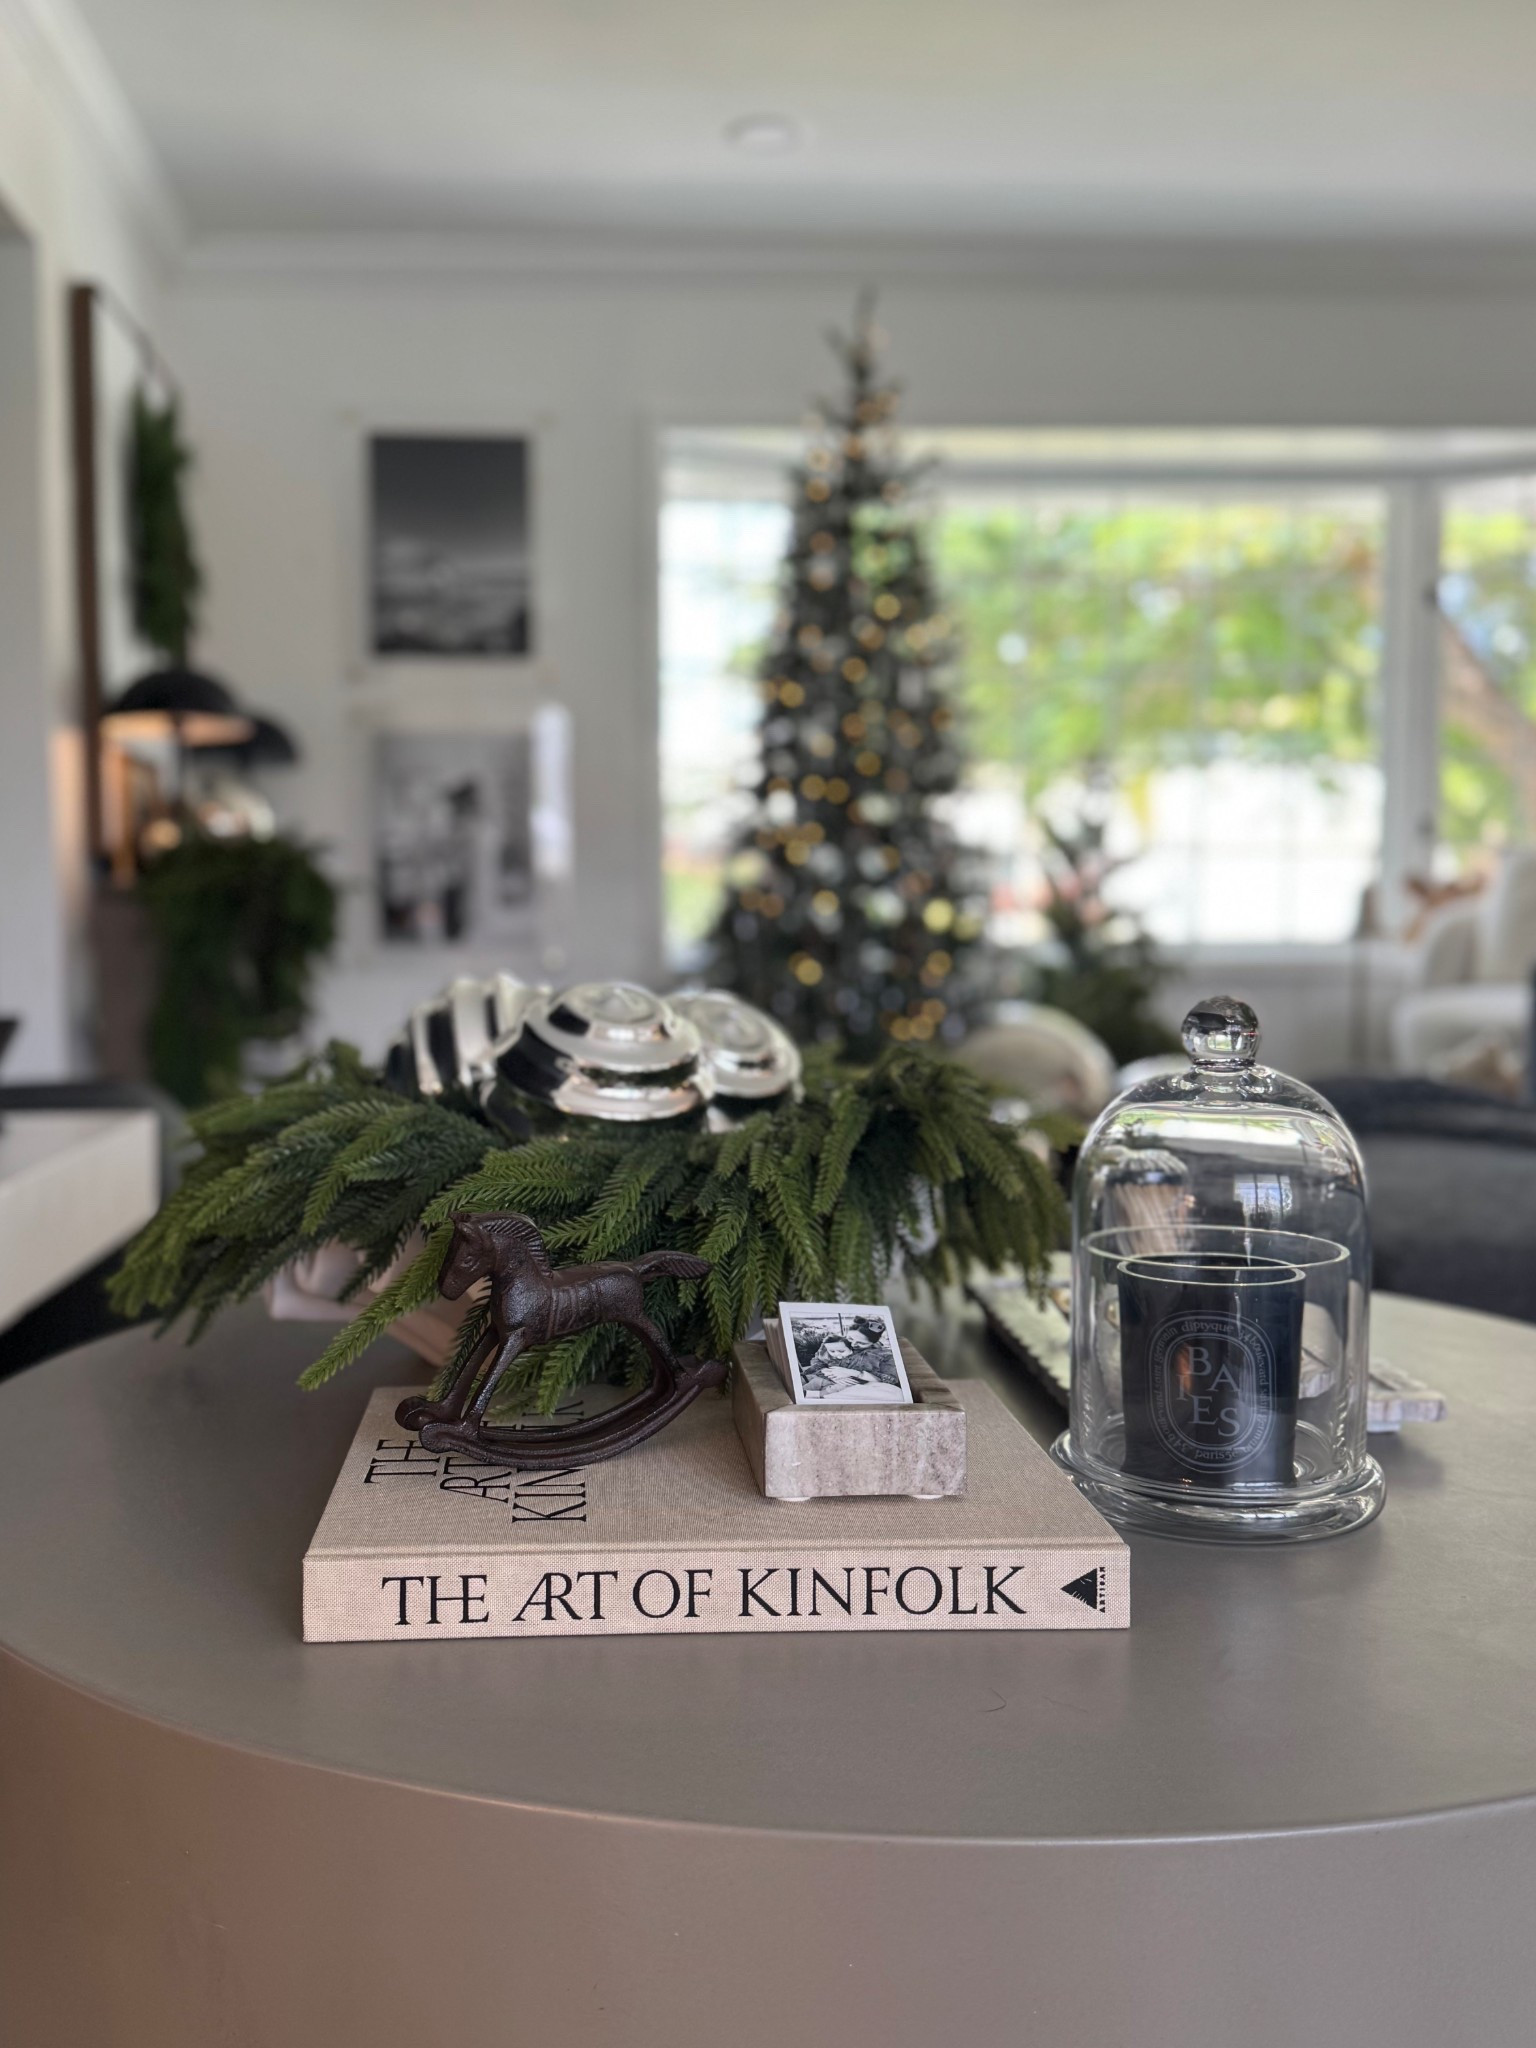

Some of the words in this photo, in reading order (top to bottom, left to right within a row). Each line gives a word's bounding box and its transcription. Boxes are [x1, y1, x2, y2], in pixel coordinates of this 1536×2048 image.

[1181, 1319, 1235, 1333] diptyque
[440, 1457, 513, 1503] ART
[382, 1574, 490, 1626] THE
[511, 1571, 619, 1622] ART
[632, 1569, 713, 1619] OF
[737, 1565, 1028, 1617] KINFOLK
